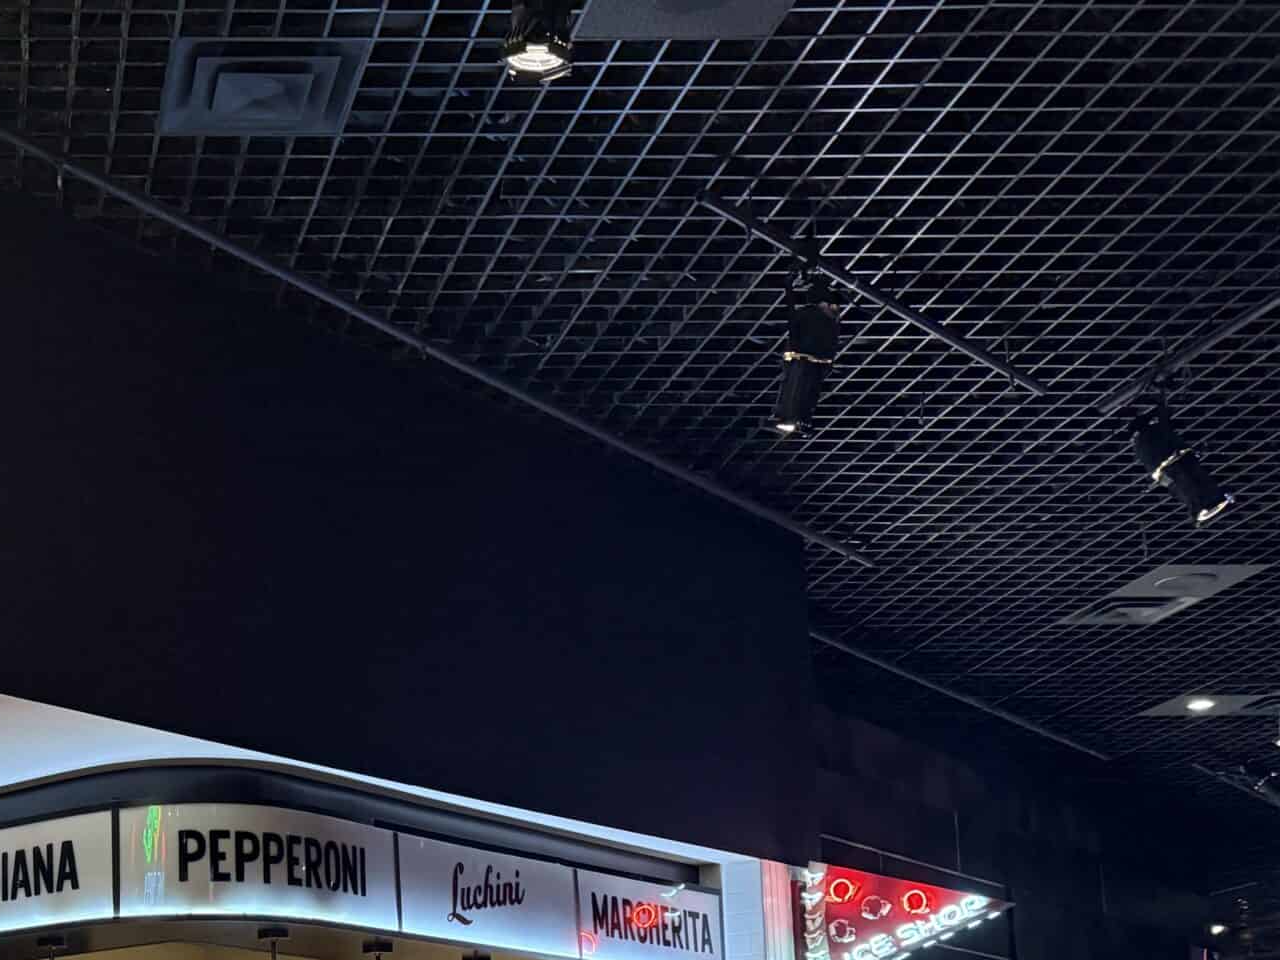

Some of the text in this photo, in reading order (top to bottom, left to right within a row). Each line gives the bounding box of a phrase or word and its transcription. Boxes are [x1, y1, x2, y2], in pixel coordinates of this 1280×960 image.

[177, 828, 368, 898] PEPPERONI
[446, 860, 527, 926] Luchini
[896, 894, 988, 946] SHOP
